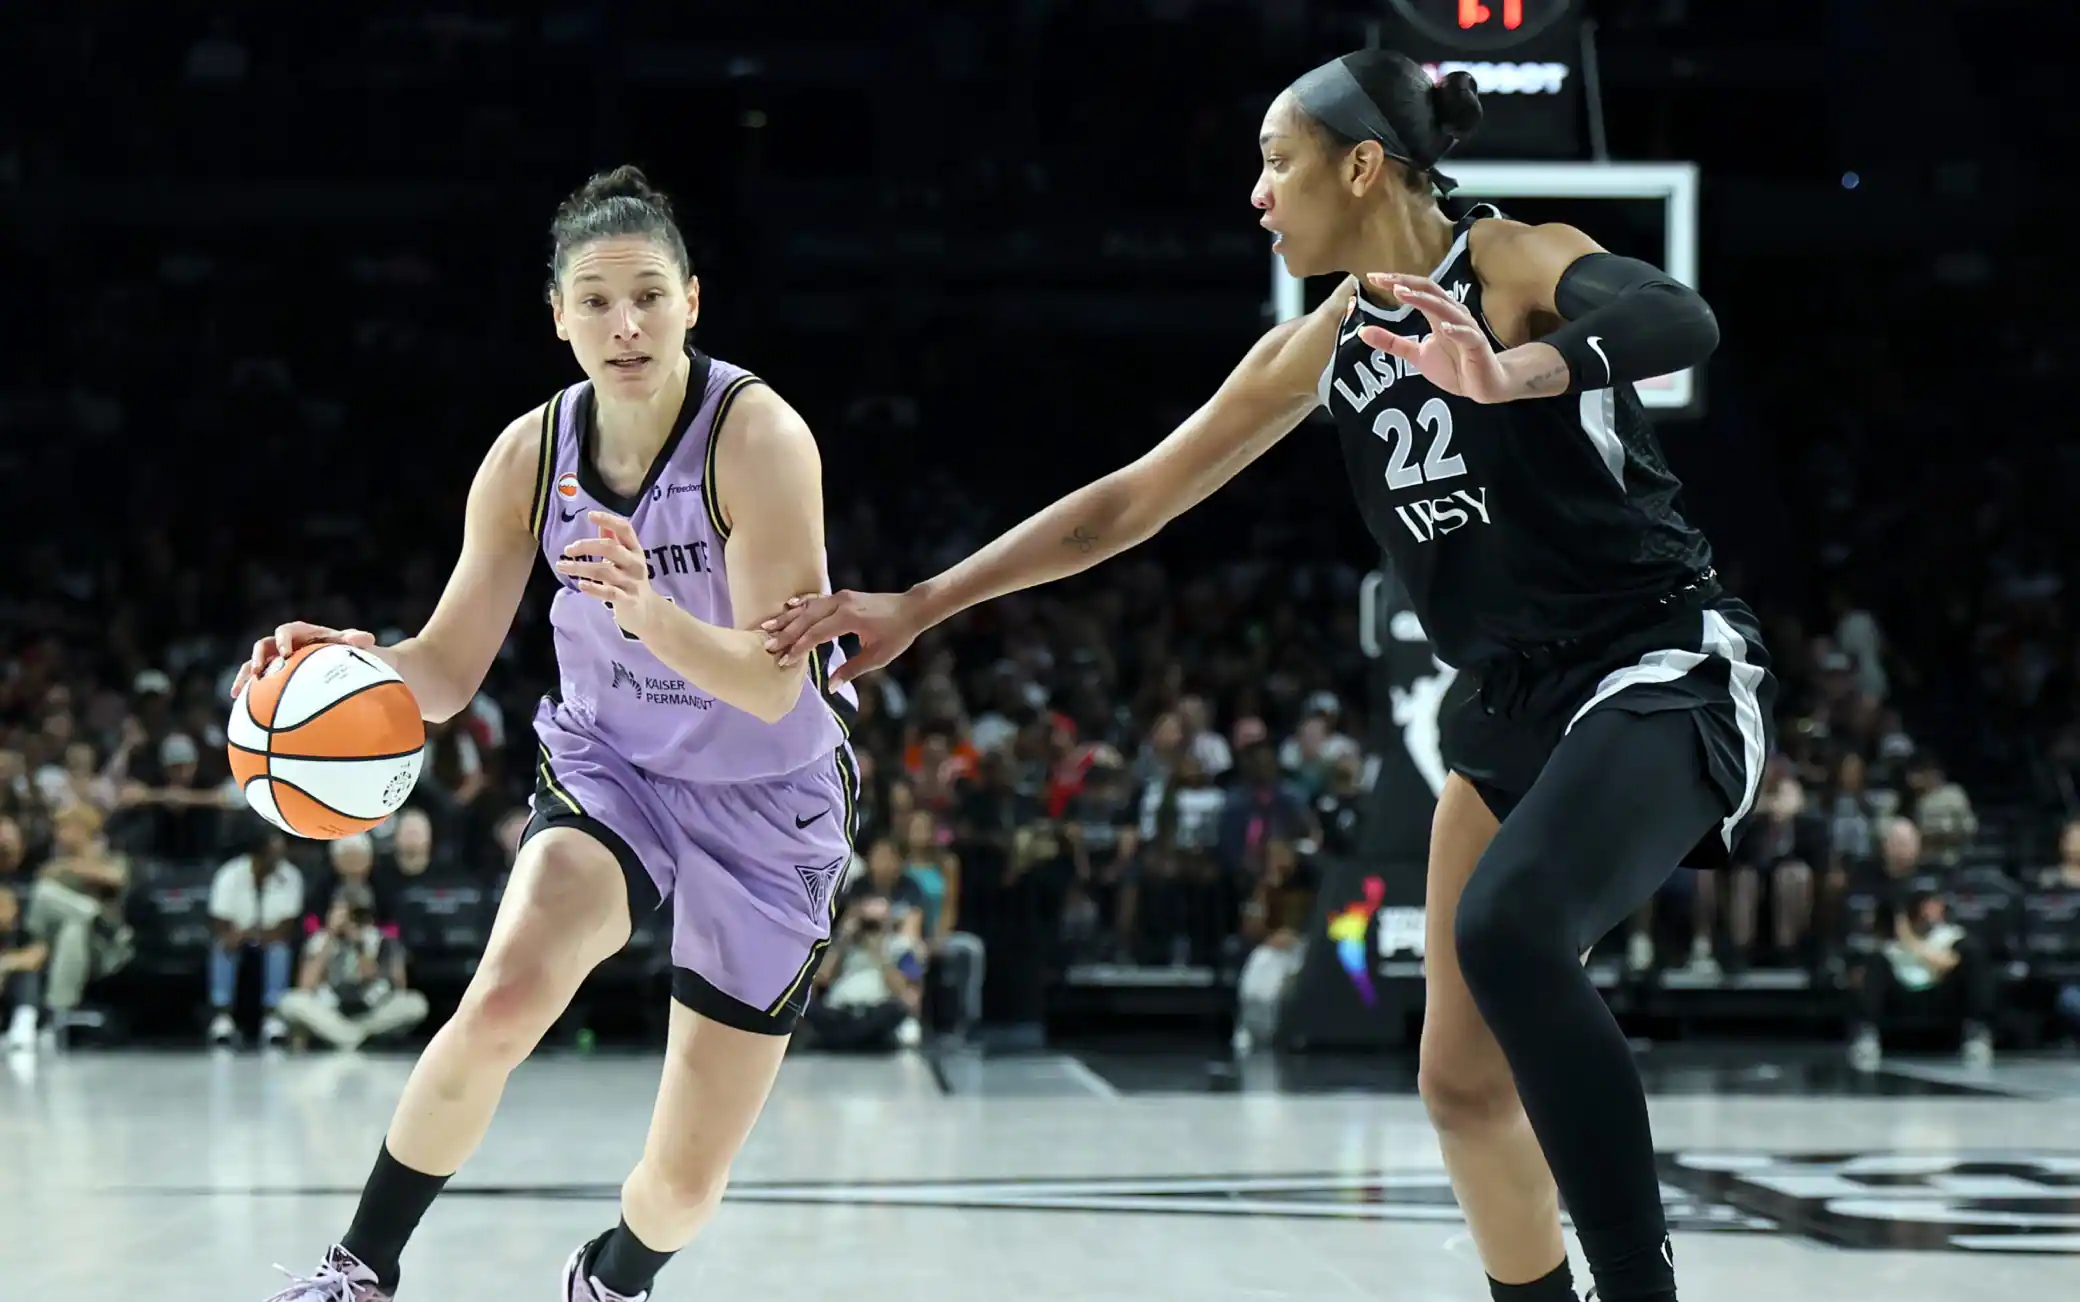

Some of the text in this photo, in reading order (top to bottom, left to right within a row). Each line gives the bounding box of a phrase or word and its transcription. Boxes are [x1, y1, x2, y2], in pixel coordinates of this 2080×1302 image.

[1372, 397, 1468, 491] 22
[1394, 486, 1491, 543] IPSY
[645, 677, 685, 691] KAISER
